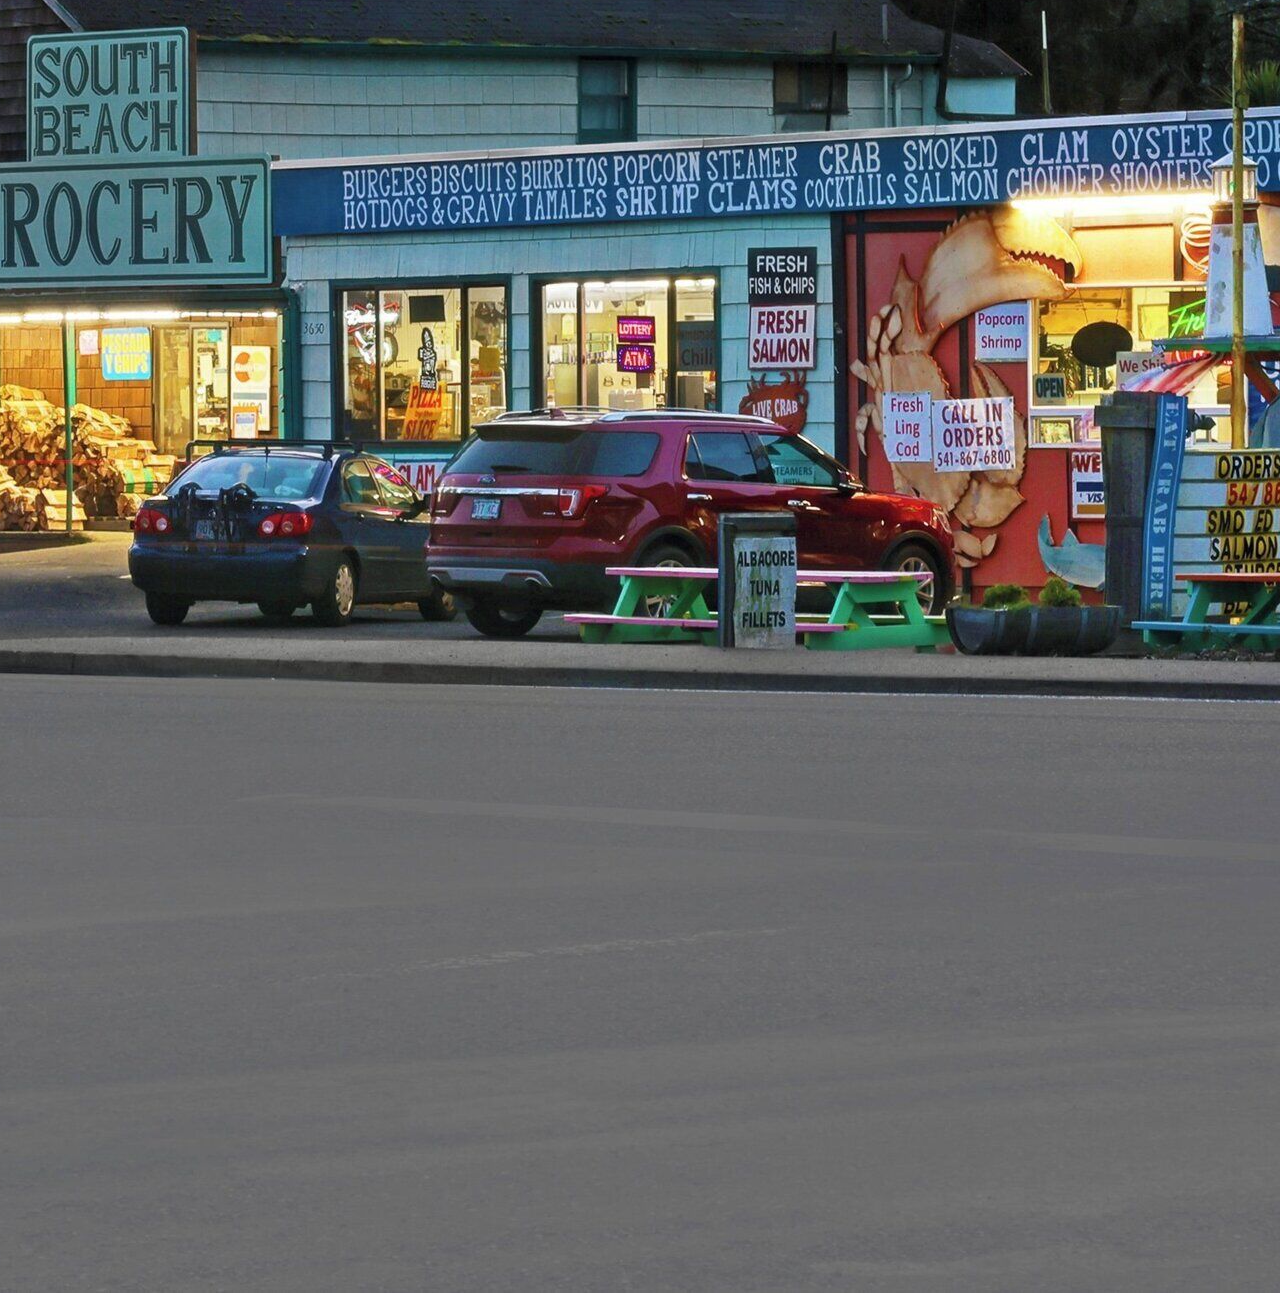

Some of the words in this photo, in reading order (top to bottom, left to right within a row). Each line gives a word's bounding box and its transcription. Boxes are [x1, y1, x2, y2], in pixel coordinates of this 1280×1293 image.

[34, 41, 178, 99] SOUTH
[34, 100, 178, 156] BEACH
[342, 166, 428, 200] BURGERS
[430, 161, 517, 195] BISCUITS
[521, 157, 608, 190] BURRITOS
[613, 151, 701, 186] POPCORN
[706, 146, 798, 181] STEAMER
[819, 141, 881, 175] CRAB
[903, 135, 998, 171] SMOKED
[1020, 130, 1089, 165] CLAM
[1112, 124, 1213, 160] OYSTER
[343, 196, 428, 230] HOTDOGS
[431, 197, 444, 226] &
[447, 193, 517, 225] GRAVY
[522, 189, 607, 221] TAMALES
[616, 183, 700, 217] SHRIMP
[708, 178, 798, 213] CLAMS
[804, 173, 896, 208] COCKTAILS
[904, 168, 999, 204] SALMON
[1006, 163, 1105, 199] CHOWDER
[1110, 158, 1214, 194] SHOOTERS
[756, 255, 808, 273] FRESH
[749, 277, 771, 294] FISH
[774, 278, 781, 294] &
[783, 276, 815, 294] CHIPS
[303, 322, 325, 335] 3650
[618, 323, 652, 335] LOTTERY
[757, 310, 808, 334] FRESH
[978, 312, 1024, 327] Popcorn
[752, 338, 810, 363] SALMON
[981, 335, 1022, 351] Shrimp
[624, 350, 647, 366] ATM
[681, 347, 713, 366] Chili
[1120, 360, 1138, 373] We
[410, 385, 442, 408] PIZZA
[1035, 378, 1065, 398] OPEN
[752, 399, 772, 417] LIVE
[774, 398, 798, 417] CRAB
[891, 398, 923, 413] Fresh
[942, 405, 978, 424] CALL
[986, 403, 1003, 423] IN
[895, 420, 920, 438] Ling
[1163, 402, 1179, 451] EAT
[943, 426, 1003, 447] ORDERS
[896, 441, 920, 456] Cod
[937, 449, 1011, 467] 541-867-6800
[775, 466, 813, 476] TEAMERS
[1073, 453, 1101, 473] WE
[1153, 462, 1174, 534] CRAB
[1228, 482, 1259, 506] 541
[1211, 536, 1278, 561] SALMON
[737, 550, 796, 567] ALBACORE
[750, 579, 780, 596] TUNA
[742, 610, 786, 628] FILLETS
